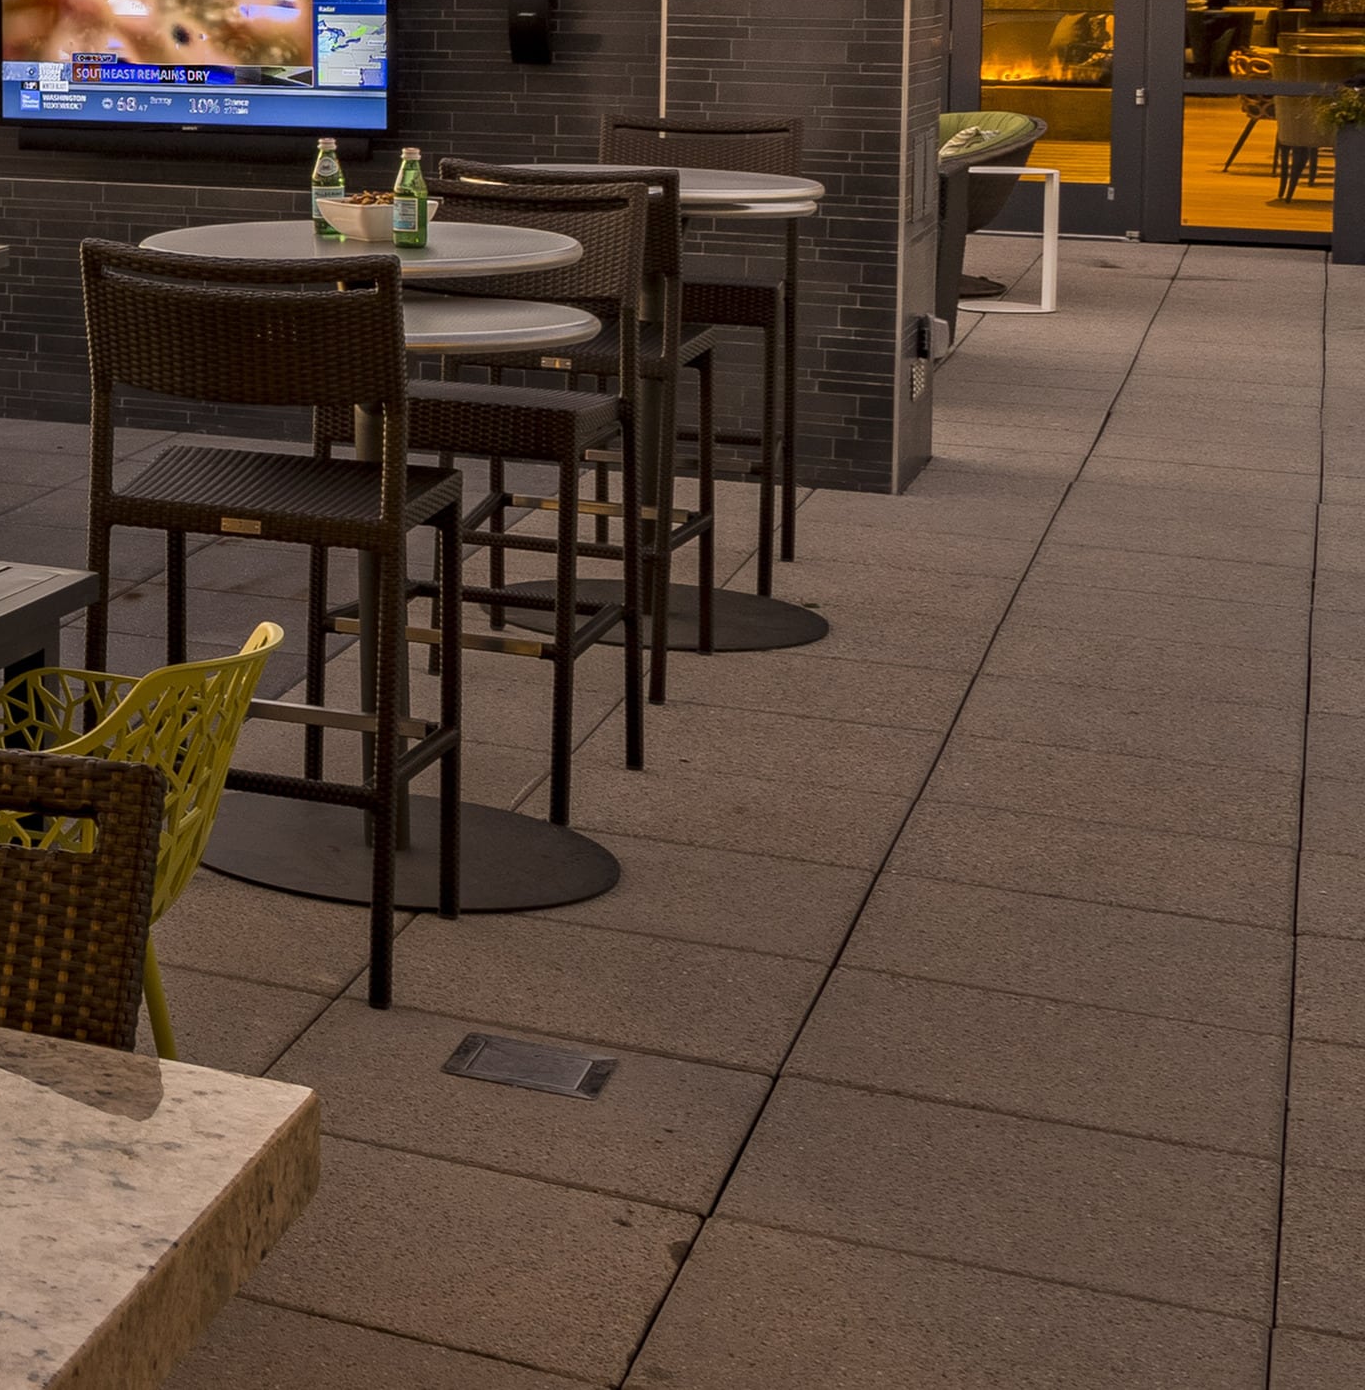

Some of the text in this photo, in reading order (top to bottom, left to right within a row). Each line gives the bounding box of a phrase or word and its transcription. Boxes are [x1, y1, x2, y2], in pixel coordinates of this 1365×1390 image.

[76, 67, 136, 80] SOUTHEAST
[137, 69, 186, 81] REMAINS
[187, 70, 211, 82] DRY
[42, 93, 87, 102] WASHINGTON
[116, 96, 137, 112] 68
[189, 97, 221, 114] 10%
